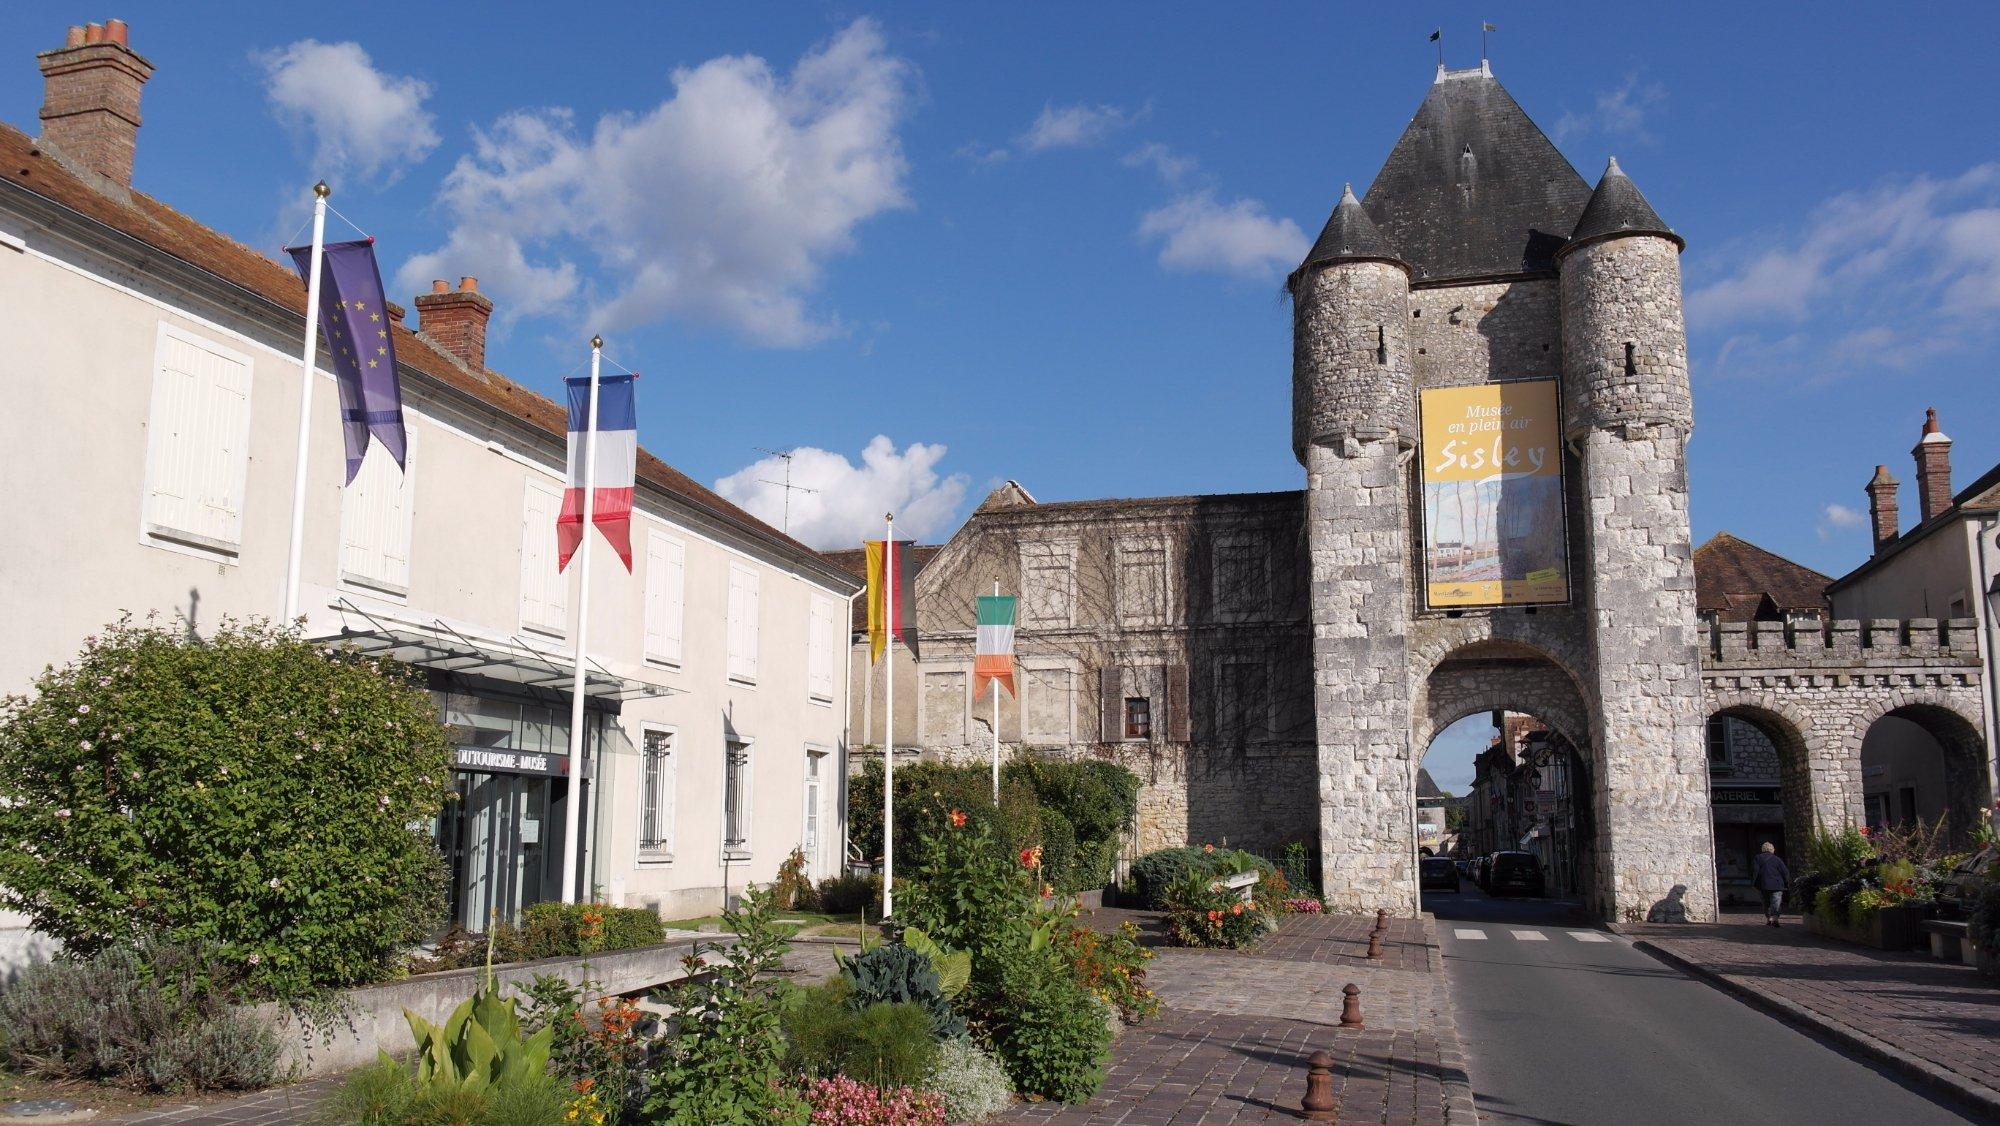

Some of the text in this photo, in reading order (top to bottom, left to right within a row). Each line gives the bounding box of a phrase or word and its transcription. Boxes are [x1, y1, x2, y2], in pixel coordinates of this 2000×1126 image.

[1466, 403, 1512, 419] Musée
[1448, 417, 1532, 435] en plein air
[1435, 435, 1547, 486] Sisley
[458, 749, 471, 764] DU
[472, 750, 516, 768] TOURISME
[520, 754, 547, 771] MUSÉE
